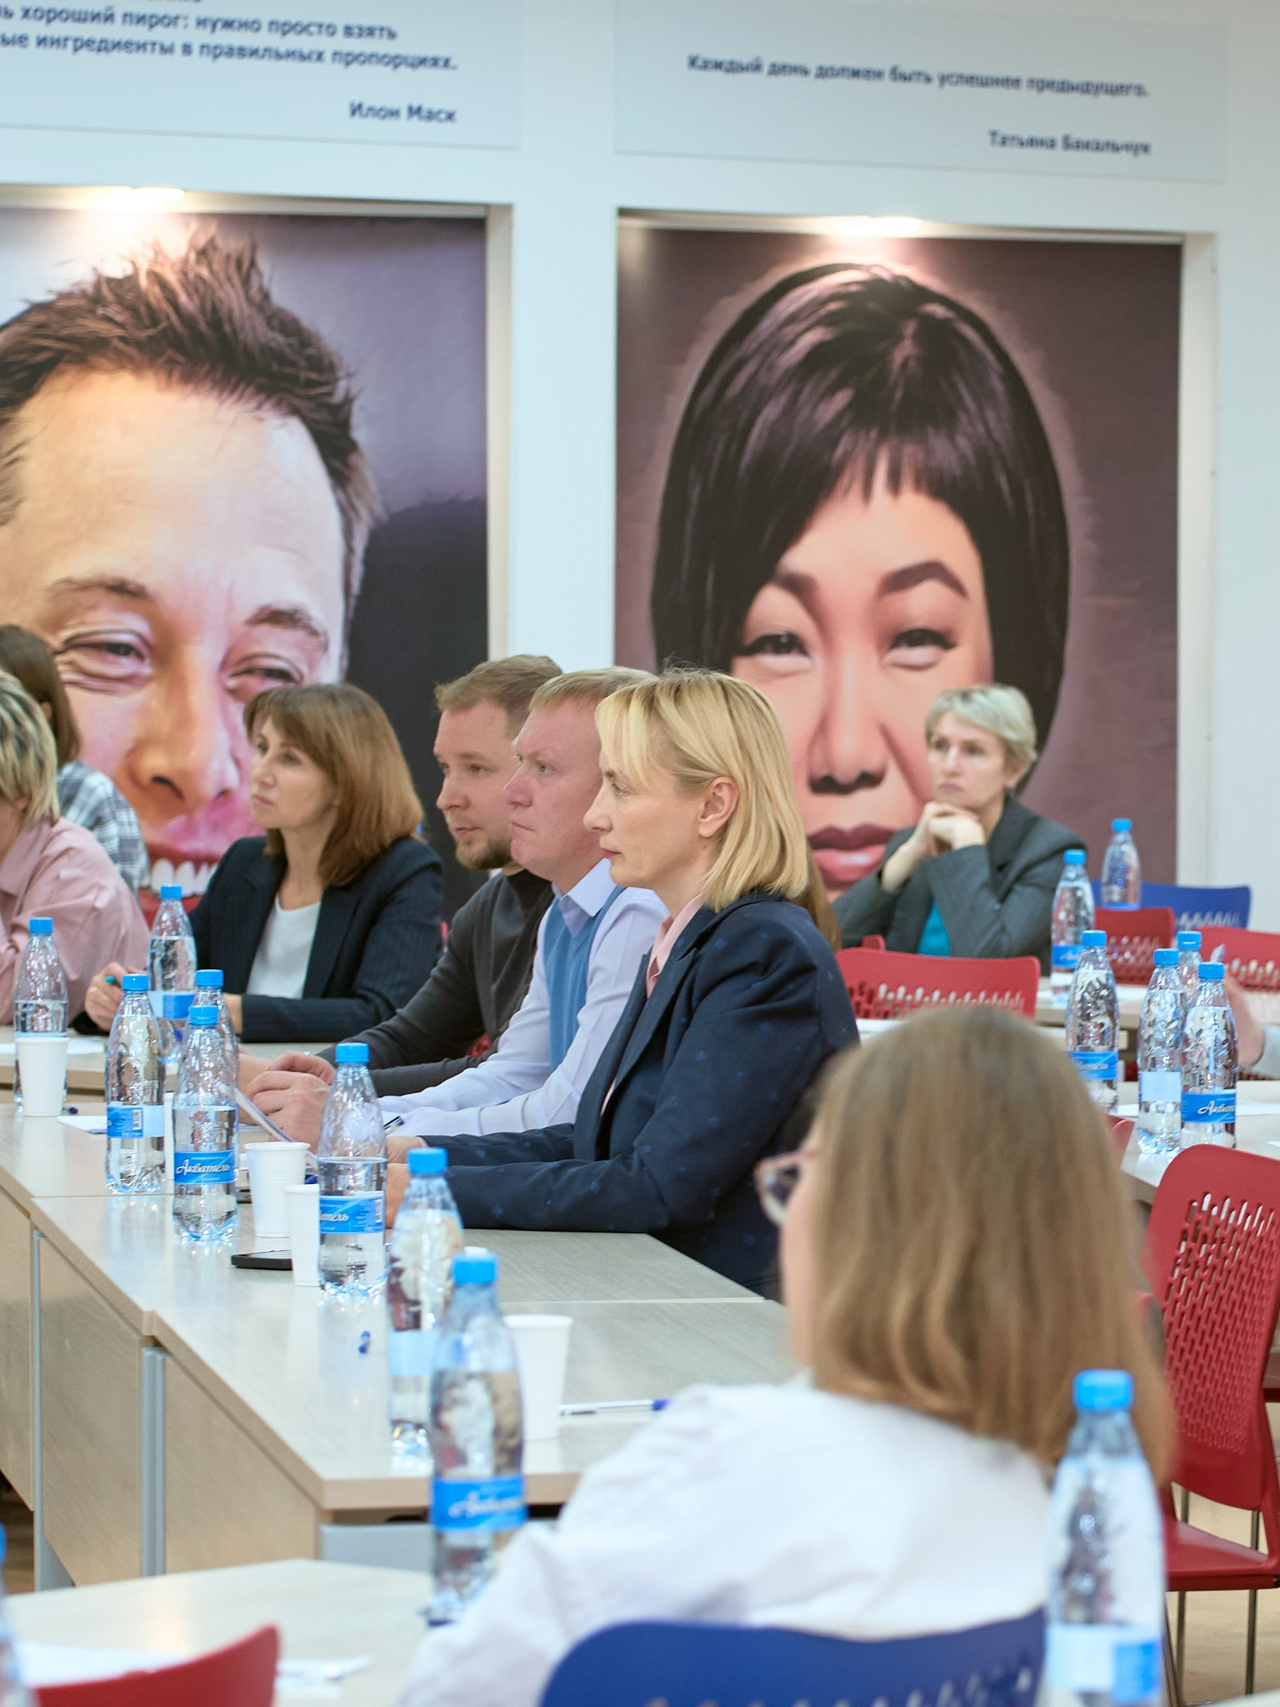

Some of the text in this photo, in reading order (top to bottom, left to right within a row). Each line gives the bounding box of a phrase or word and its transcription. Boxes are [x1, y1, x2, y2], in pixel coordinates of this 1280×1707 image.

[21, 6, 115, 26] хороший
[122, 12, 188, 31] пирог:
[196, 17, 262, 34] нужно
[268, 20, 337, 38] просто
[343, 24, 398, 40] взять
[36, 35, 175, 55] ингредиенты
[181, 42, 193, 56] в
[199, 43, 325, 63] правильных
[331, 50, 457, 71] пропорциях.
[688, 55, 763, 74] Каждый
[767, 62, 811, 77] день
[814, 65, 885, 81] должен
[889, 65, 933, 84] быть
[937, 73, 1022, 90] успешнее
[350, 102, 456, 123] Илон Маск
[989, 130, 1151, 156] Татьяна Бакальчук
